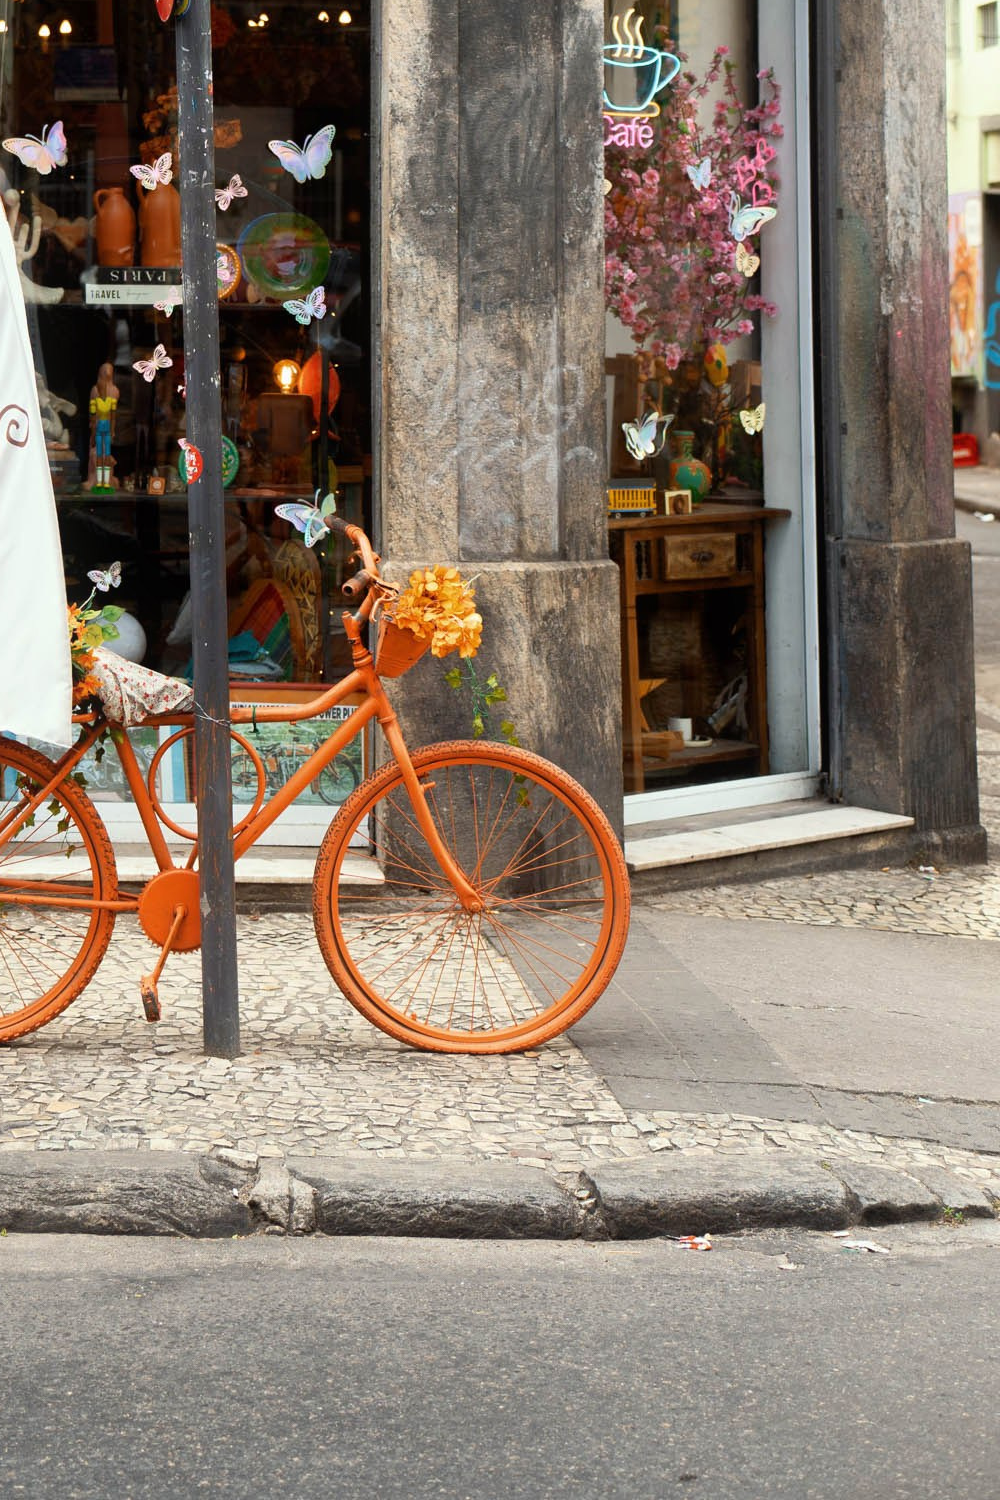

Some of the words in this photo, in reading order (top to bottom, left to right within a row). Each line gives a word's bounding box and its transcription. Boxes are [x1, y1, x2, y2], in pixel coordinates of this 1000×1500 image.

[603, 116, 654, 149] Café
[109, 269, 167, 283] PARIS
[90, 289, 121, 300] TRAVEL
